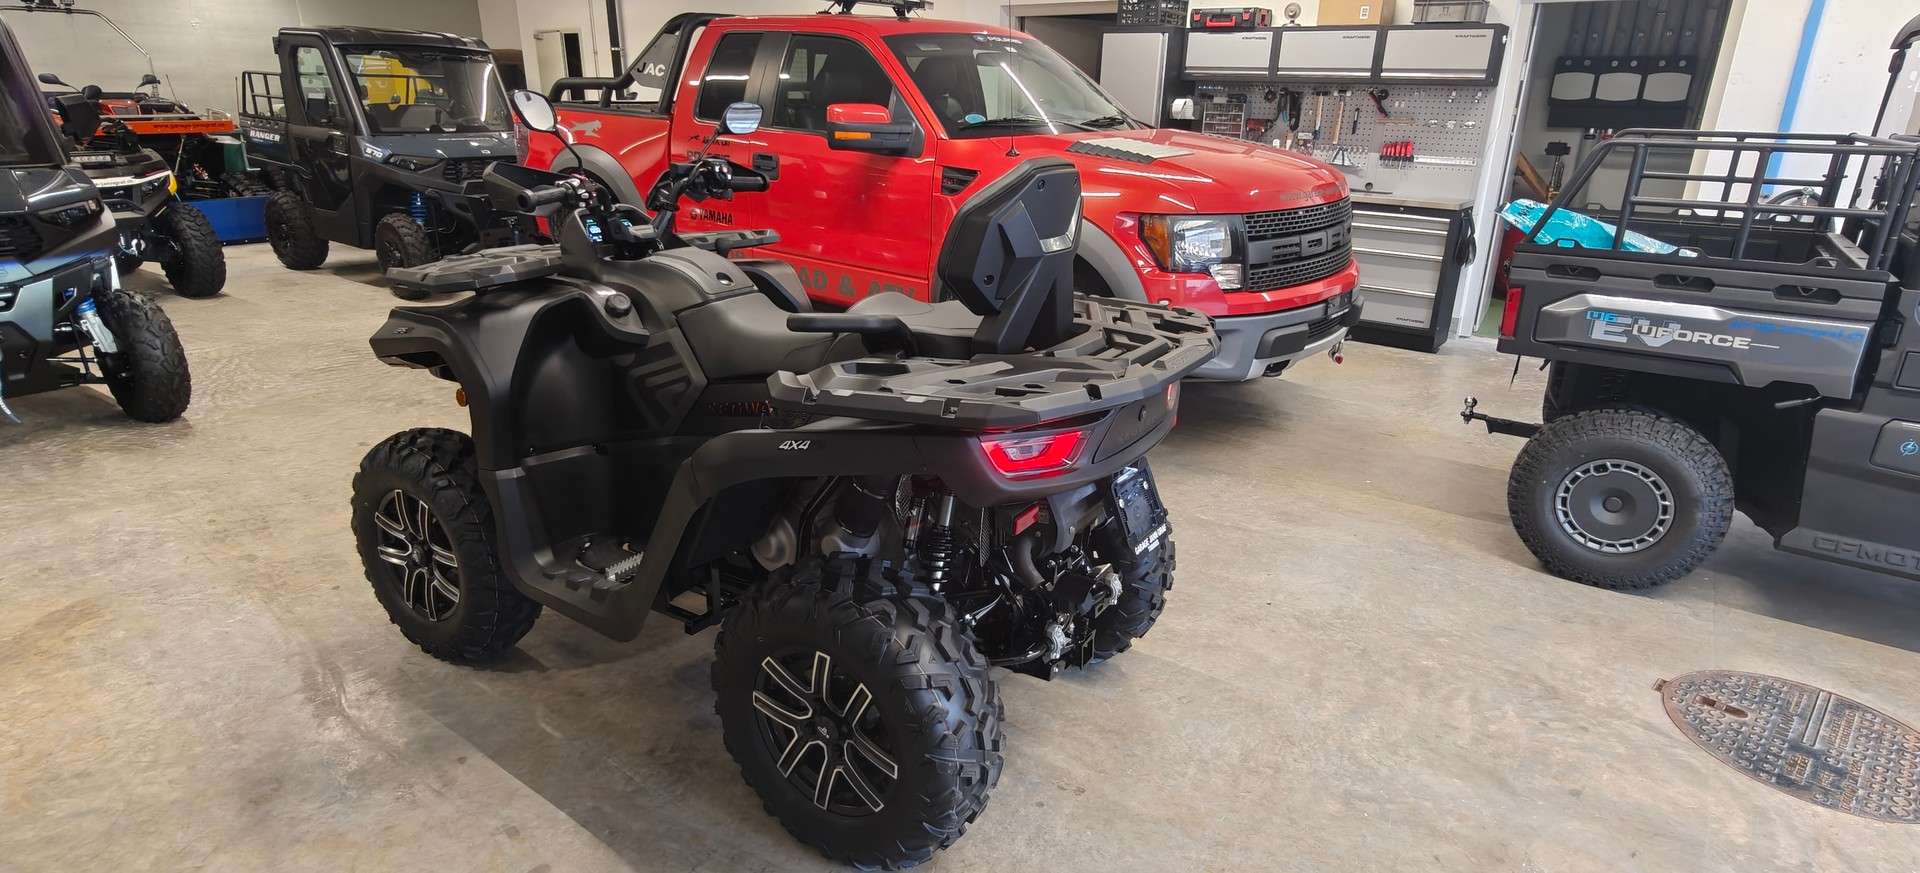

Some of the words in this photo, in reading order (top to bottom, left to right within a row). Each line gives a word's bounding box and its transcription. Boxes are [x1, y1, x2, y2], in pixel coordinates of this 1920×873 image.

[986, 36, 1023, 44] POLARIS
[636, 61, 666, 77] JAC
[250, 130, 280, 142] RANGER
[699, 208, 733, 225] YAMAHA
[799, 266, 828, 290] AD
[837, 273, 856, 297] &
[1395, 316, 1425, 324] KRAFTWERK
[1632, 323, 1752, 350] UFORCE
[778, 440, 811, 450] 4X4
